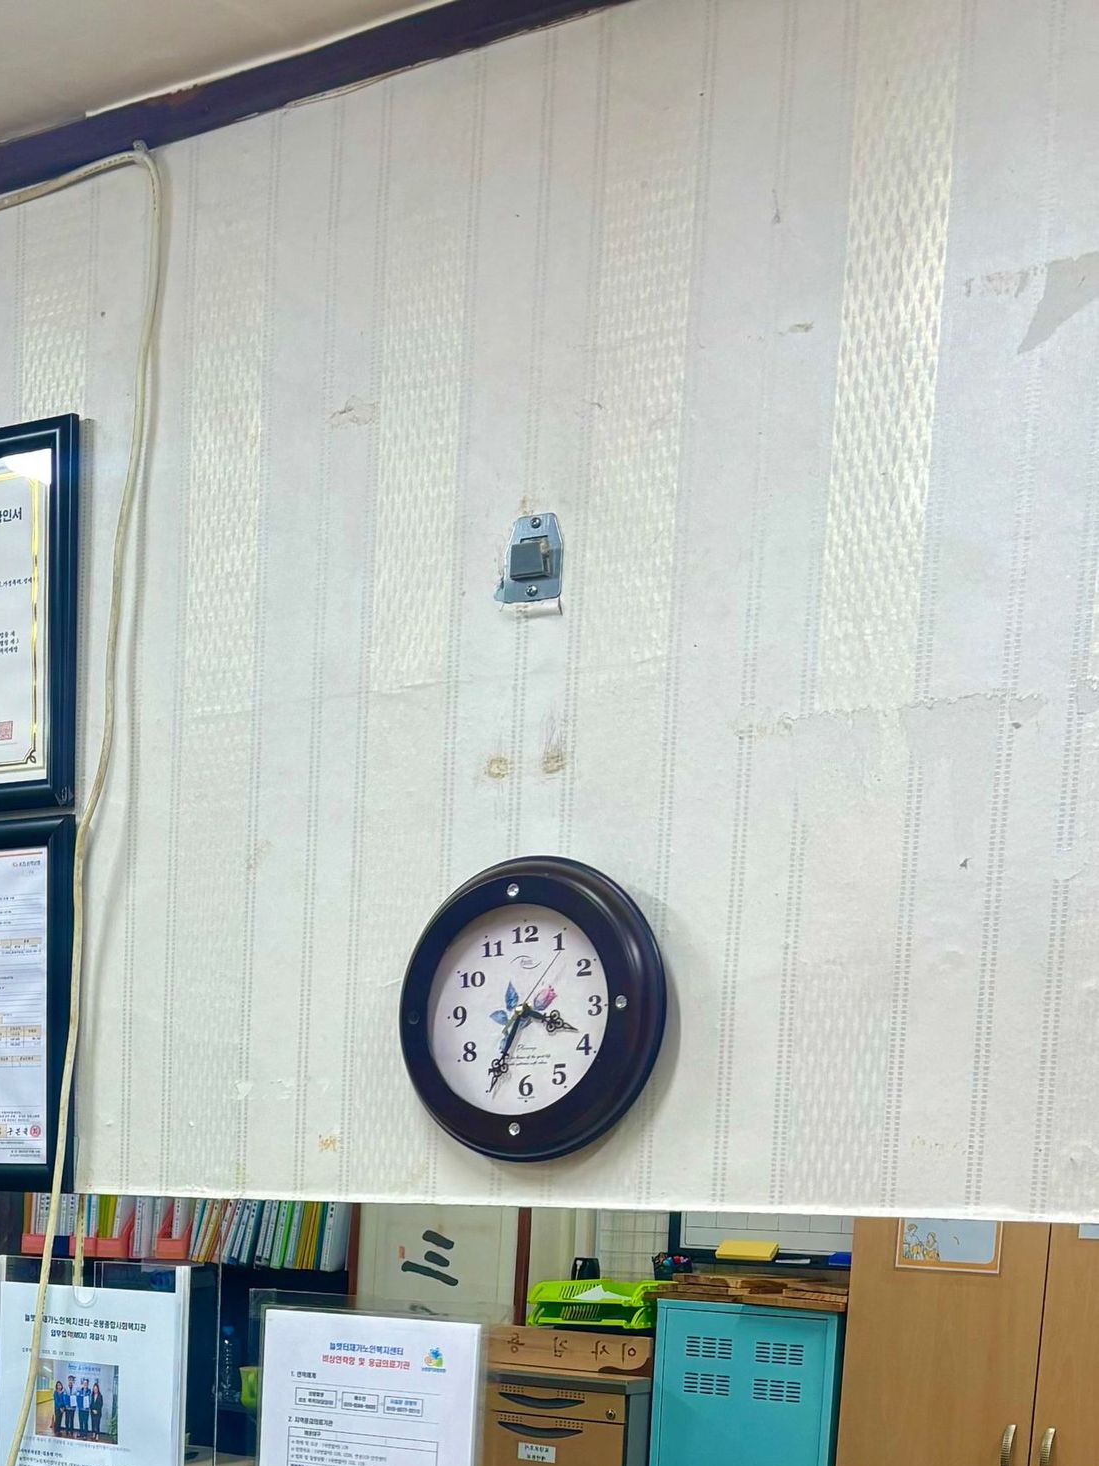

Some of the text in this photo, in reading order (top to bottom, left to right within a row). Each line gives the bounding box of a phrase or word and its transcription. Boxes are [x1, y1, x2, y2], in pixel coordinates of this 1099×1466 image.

[511, 925, 539, 944] 12
[553, 933, 566, 951] 1
[481, 940, 504, 958] 11
[576, 958, 592, 977] 2
[460, 971, 485, 989] 10
[588, 995, 603, 1017] 3
[453, 1006, 467, 1028] 9
[462, 1041, 477, 1062] 8
[576, 1034, 591, 1056] 4
[552, 1063, 567, 1086] 5
[518, 1074, 534, 1097] 6
